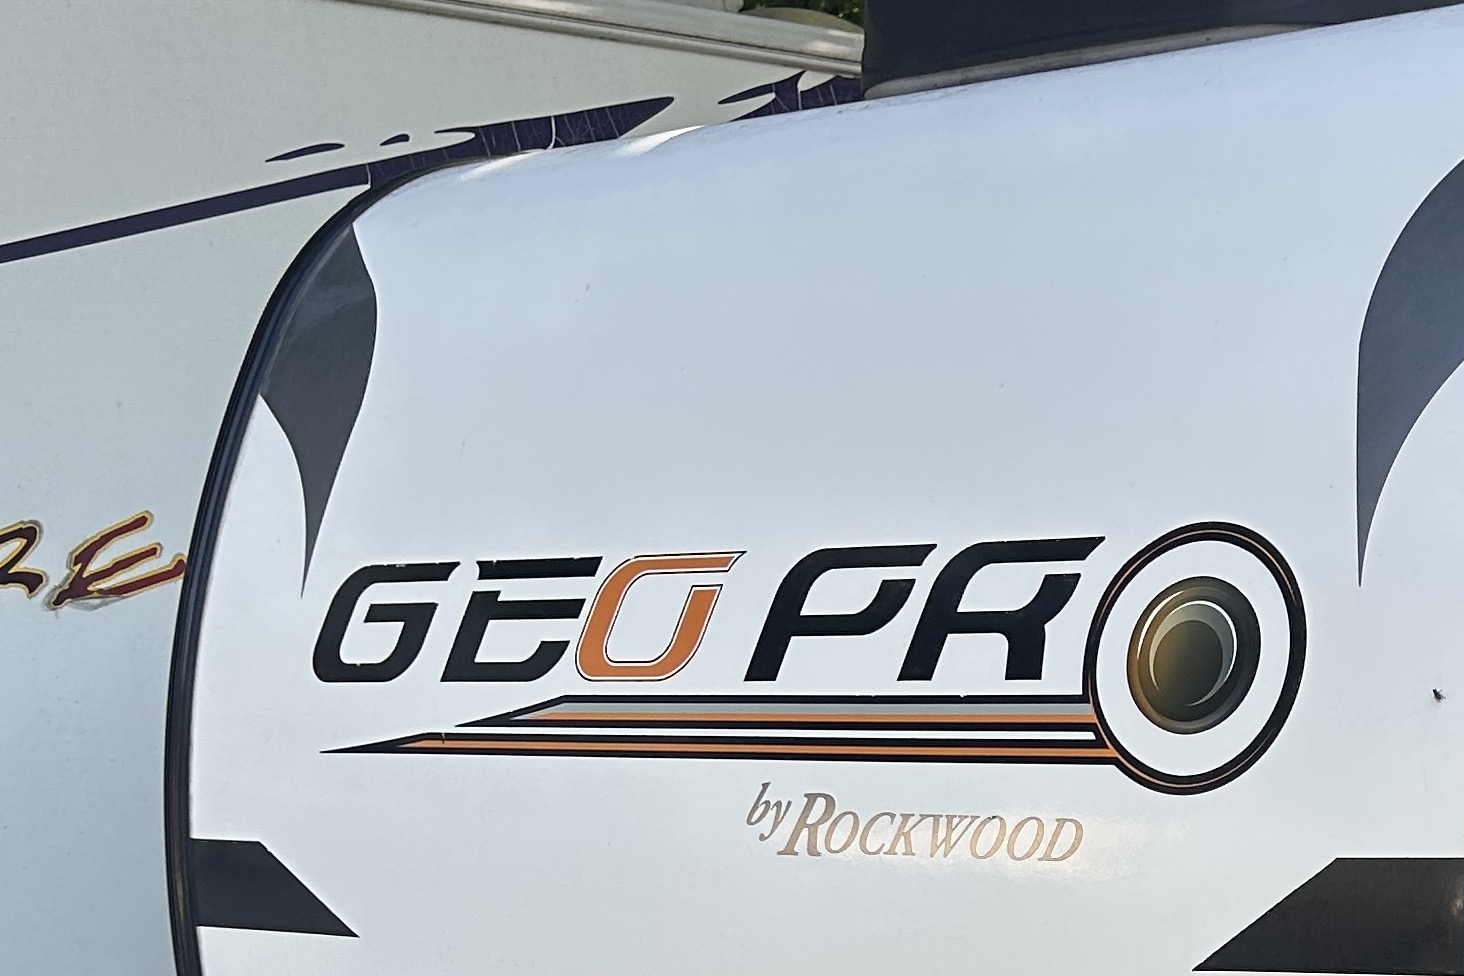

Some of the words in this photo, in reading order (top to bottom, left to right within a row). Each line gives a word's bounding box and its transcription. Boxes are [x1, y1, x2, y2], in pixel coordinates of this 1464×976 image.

[312, 550, 747, 683] GEO
[746, 782, 792, 842] by
[777, 792, 1085, 863] ROCKWOOD
